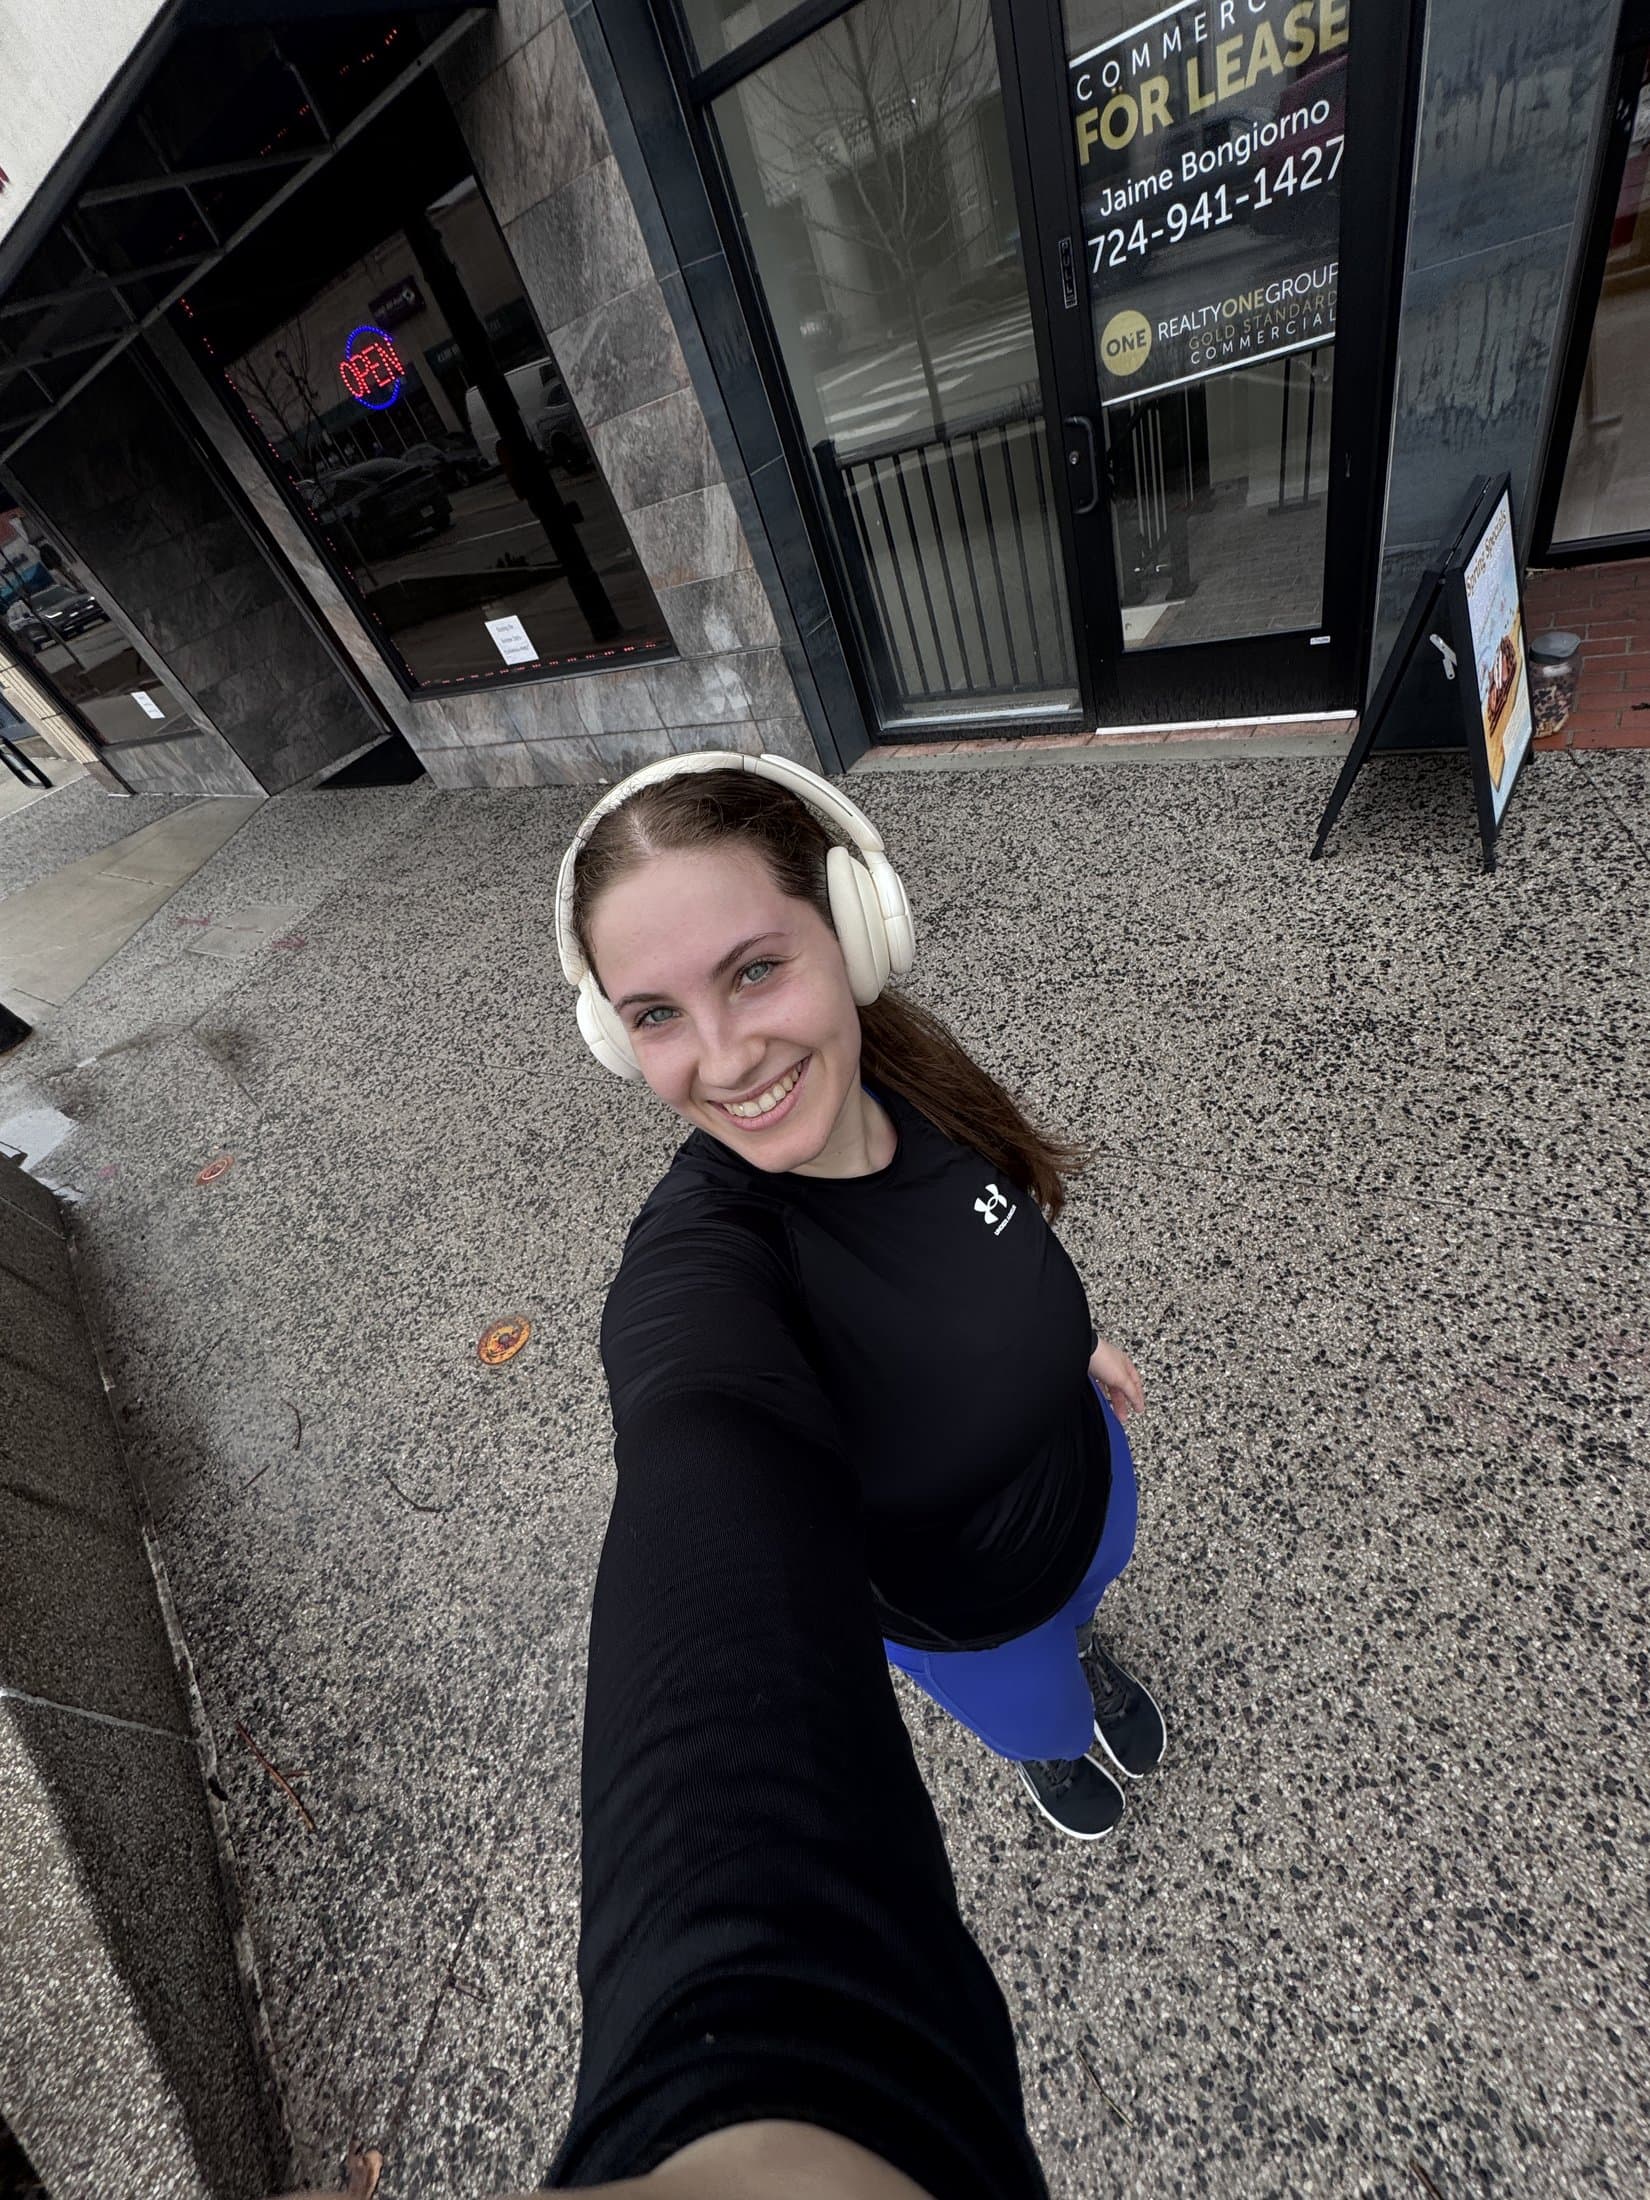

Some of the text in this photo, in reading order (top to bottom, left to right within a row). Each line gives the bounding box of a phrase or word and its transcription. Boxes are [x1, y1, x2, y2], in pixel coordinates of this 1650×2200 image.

[1075, 0, 1348, 166] FOR LEASE
[1099, 99, 1330, 217] Jaime Bongiorno
[1087, 134, 1345, 274] 724-941-1427
[1106, 328, 1147, 357] ONE
[1188, 290, 1337, 351] GOLD STANDARD
[1190, 309, 1337, 365] COMMERCIAL
[339, 336, 406, 398] OPEN
